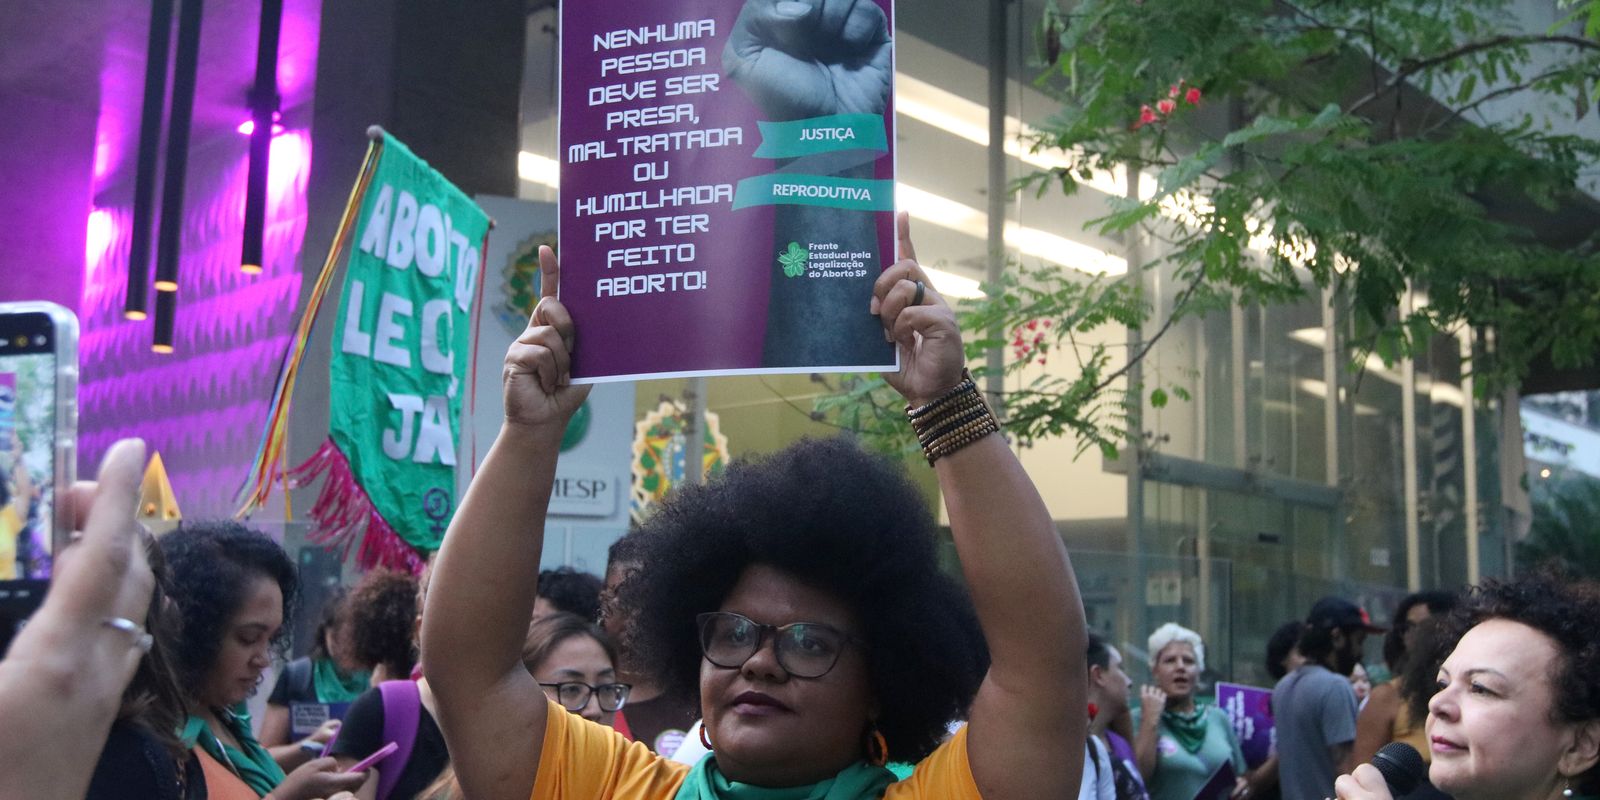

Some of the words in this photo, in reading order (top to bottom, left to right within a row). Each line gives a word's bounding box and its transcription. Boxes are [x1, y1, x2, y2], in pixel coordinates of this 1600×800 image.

[594, 19, 715, 51] NENHUMA
[602, 47, 705, 77] PESSOA
[589, 80, 656, 106] DEVE
[666, 74, 719, 95] SER
[607, 104, 699, 130] PRESA,
[569, 127, 742, 163] MALTRATADA
[800, 128, 855, 141] JUSTIÇA
[634, 161, 667, 182] OU
[576, 184, 732, 217] HUMILHADA
[773, 184, 871, 200] REPRODUTIVA
[596, 220, 645, 242] POR
[655, 215, 708, 234] TER
[608, 244, 694, 268] FEITO
[809, 260, 864, 270] Legalização
[851, 252, 871, 260] pela
[597, 271, 706, 297] ABORTO!
